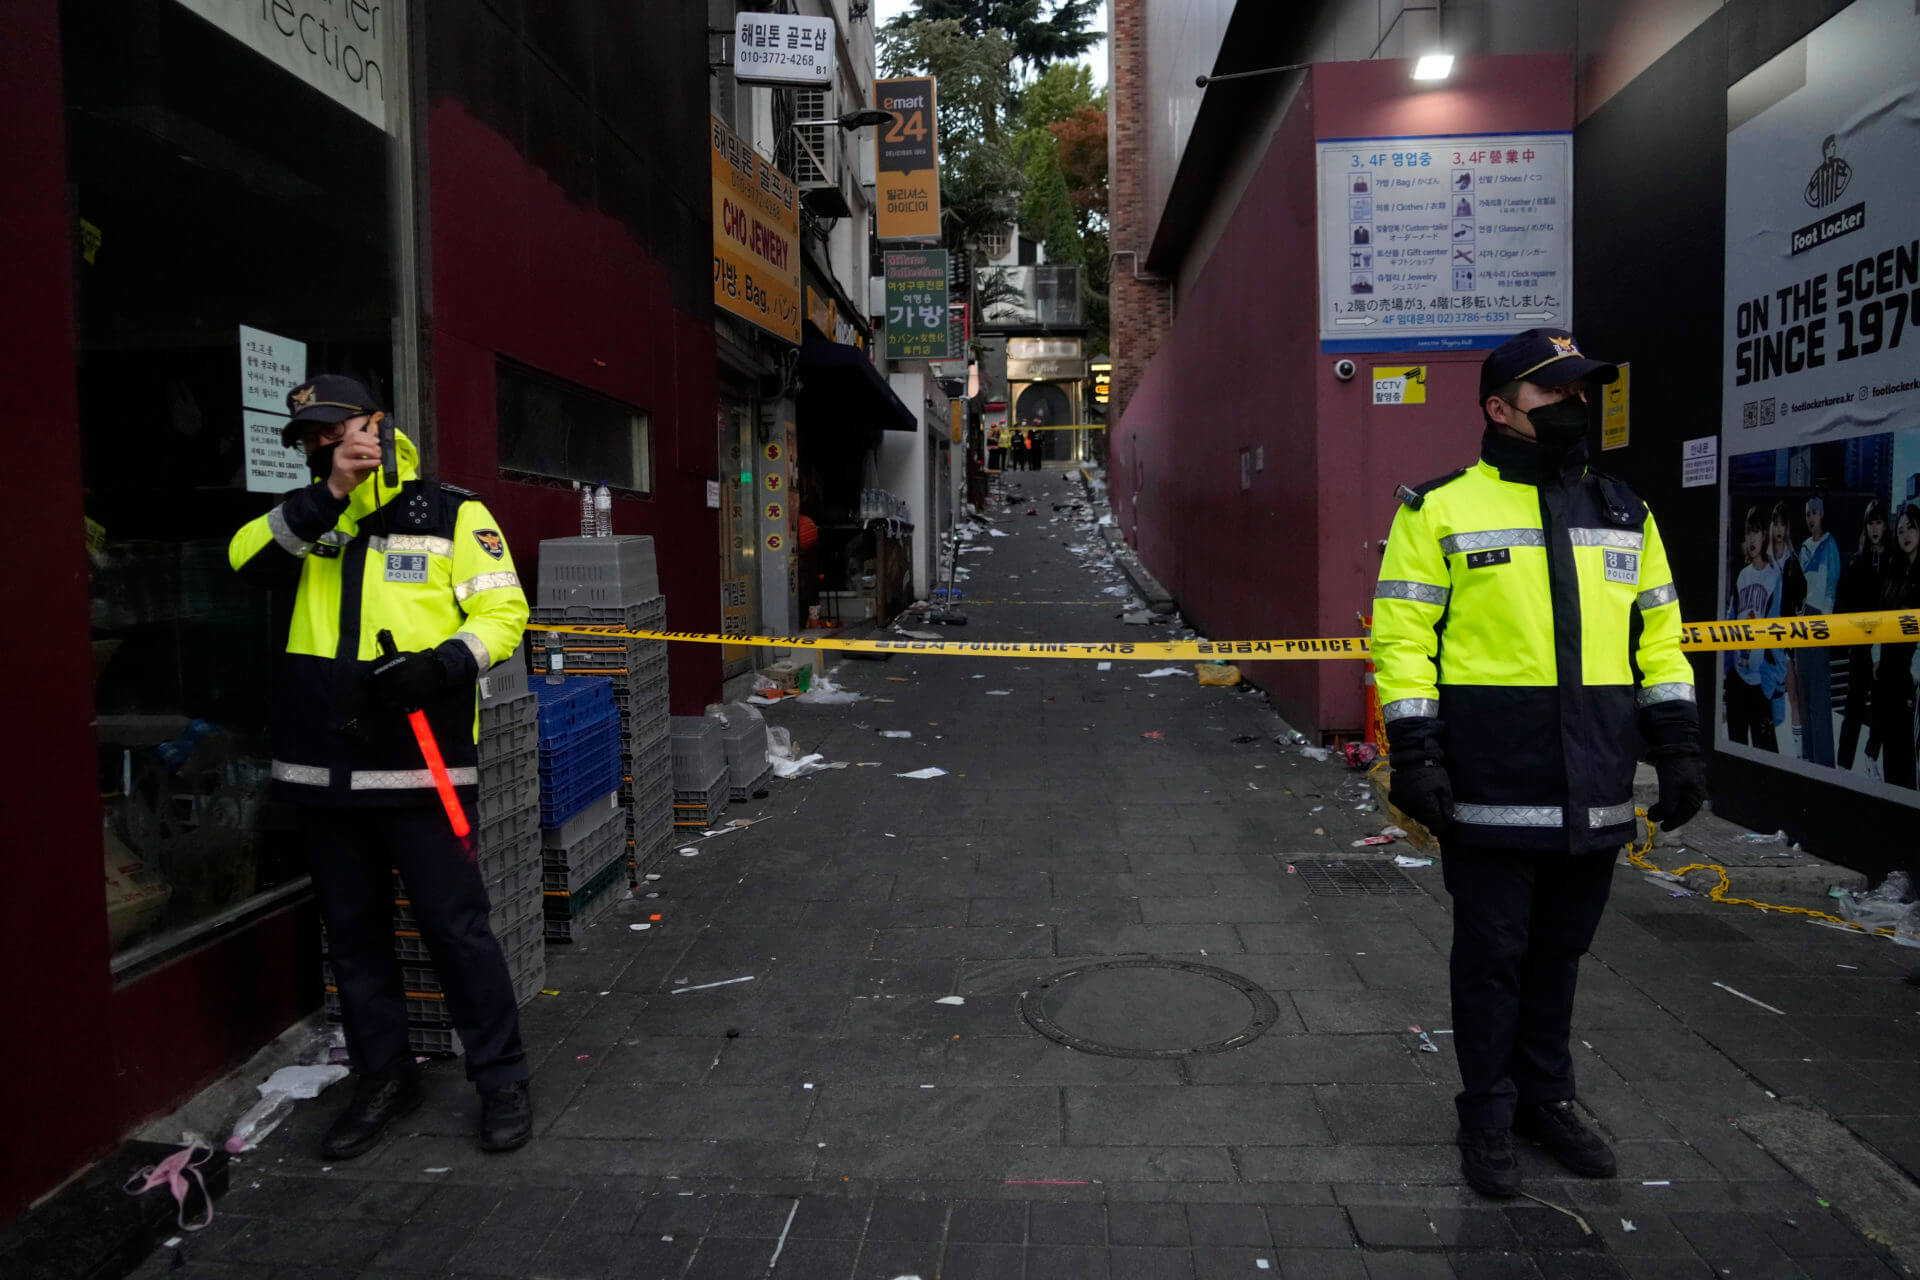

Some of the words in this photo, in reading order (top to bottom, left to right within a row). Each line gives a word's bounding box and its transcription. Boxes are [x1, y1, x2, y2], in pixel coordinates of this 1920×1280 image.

[741, 24, 780, 47] 해밀톤
[787, 26, 826, 51] 골프샵
[741, 52, 815, 66] 010-3772-4268
[816, 66, 827, 75] B1
[884, 95, 924, 110] emart
[885, 110, 928, 143] 24
[1369, 153, 1387, 167] 4F
[1392, 152, 1432, 167] 영업중
[1469, 151, 1486, 164] 4F
[714, 124, 753, 180] 해밀톤
[759, 162, 793, 211] 골프샵
[1396, 179, 1411, 188] Bag
[1478, 175, 1493, 184] 신발
[1499, 174, 1522, 183] Shoes
[1529, 174, 1543, 182] くつ
[887, 189, 928, 201] 딜리셔스
[887, 201, 928, 213] 아이디어
[1396, 202, 1425, 211] Clothes
[1498, 224, 1526, 233] Glasses
[1793, 223, 1818, 253] Foot
[1821, 209, 1863, 239] Locker
[723, 198, 746, 246] CHO
[750, 216, 788, 273] JEWERY
[1406, 248, 1421, 256] Gift
[1499, 249, 1519, 259] Cigar
[1408, 272, 1437, 282] Jewelry
[1511, 270, 1529, 278] Clock
[888, 280, 945, 291] 여성구두전문
[903, 294, 932, 304] 여행용
[1737, 294, 1769, 339] ON
[1776, 273, 1827, 325] THE
[889, 305, 944, 328] 가방
[1382, 314, 1396, 324] 4F
[1397, 313, 1435, 325] 임대문의
[1736, 318, 1826, 387] SINCE
[1375, 381, 1402, 390] CCTV
[1791, 392, 1855, 413] footlockerkorea.kr
[251, 469, 274, 478] PENALTY
[388, 571, 424, 580] POLICE
[1898, 614, 1920, 636] 출
